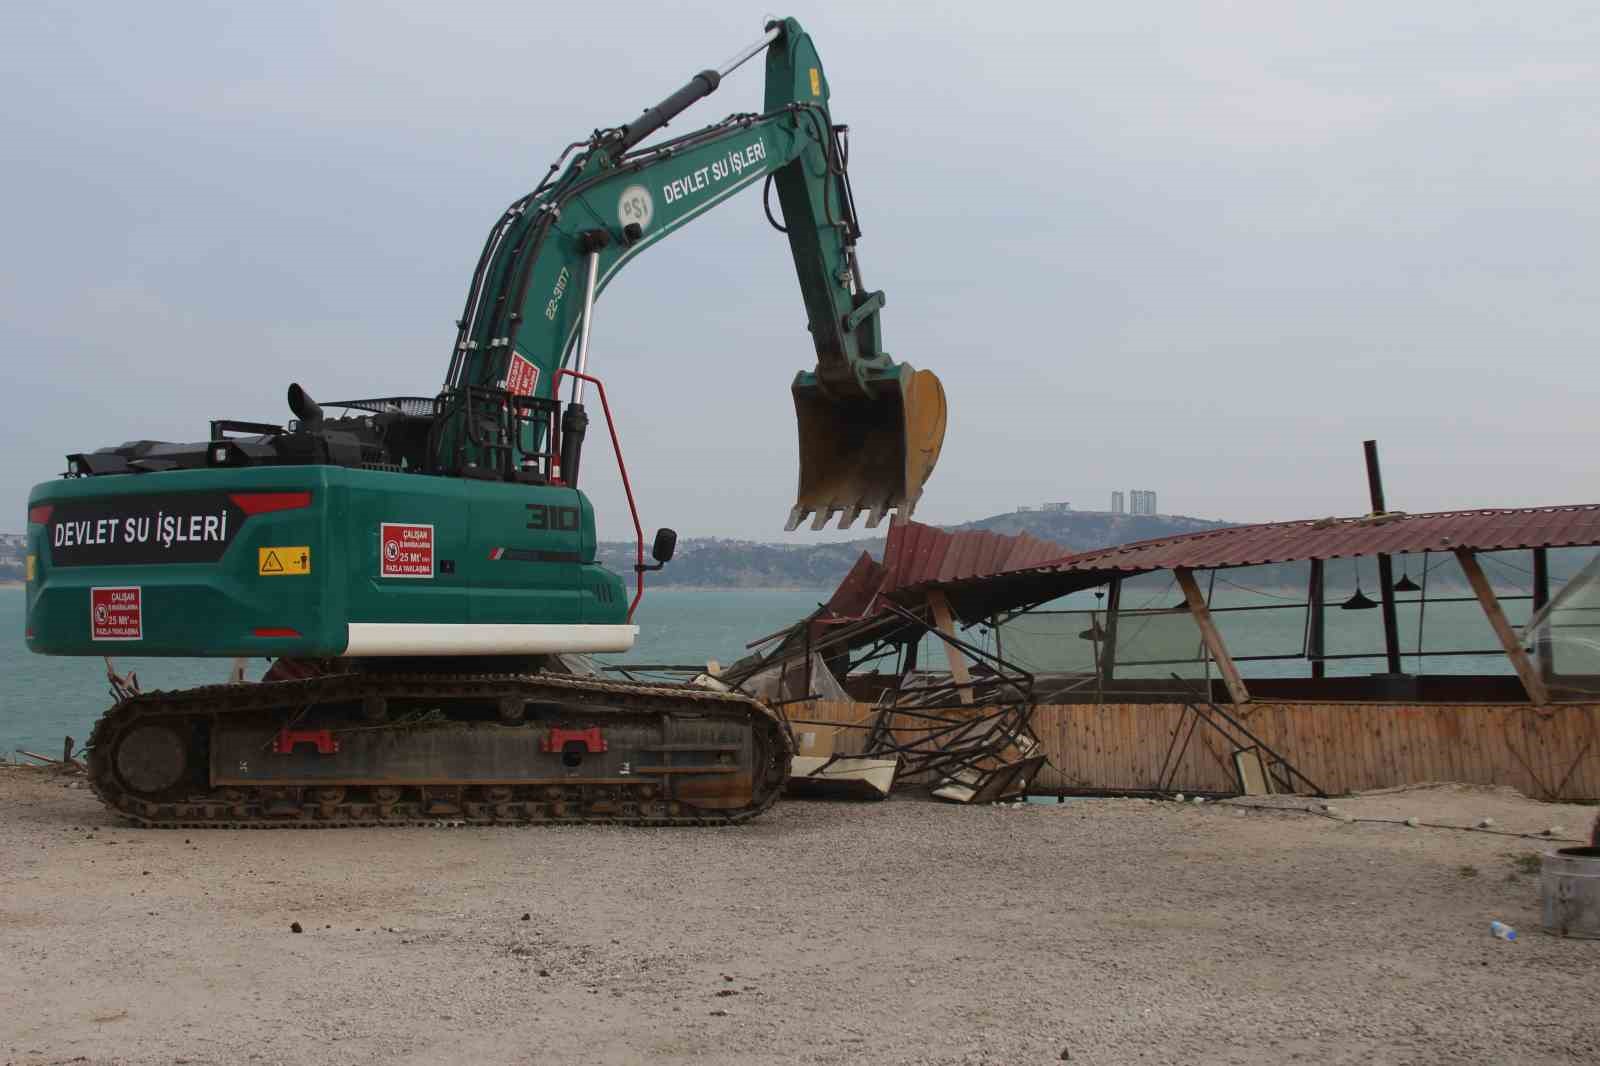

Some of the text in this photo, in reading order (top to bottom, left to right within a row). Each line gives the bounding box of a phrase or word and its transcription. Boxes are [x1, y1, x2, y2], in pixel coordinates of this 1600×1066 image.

[663, 137, 767, 204] DEVLET SU İŞLERİ
[54, 510, 227, 548] DEVLET SU İŞLERİ
[526, 504, 578, 530] 310
